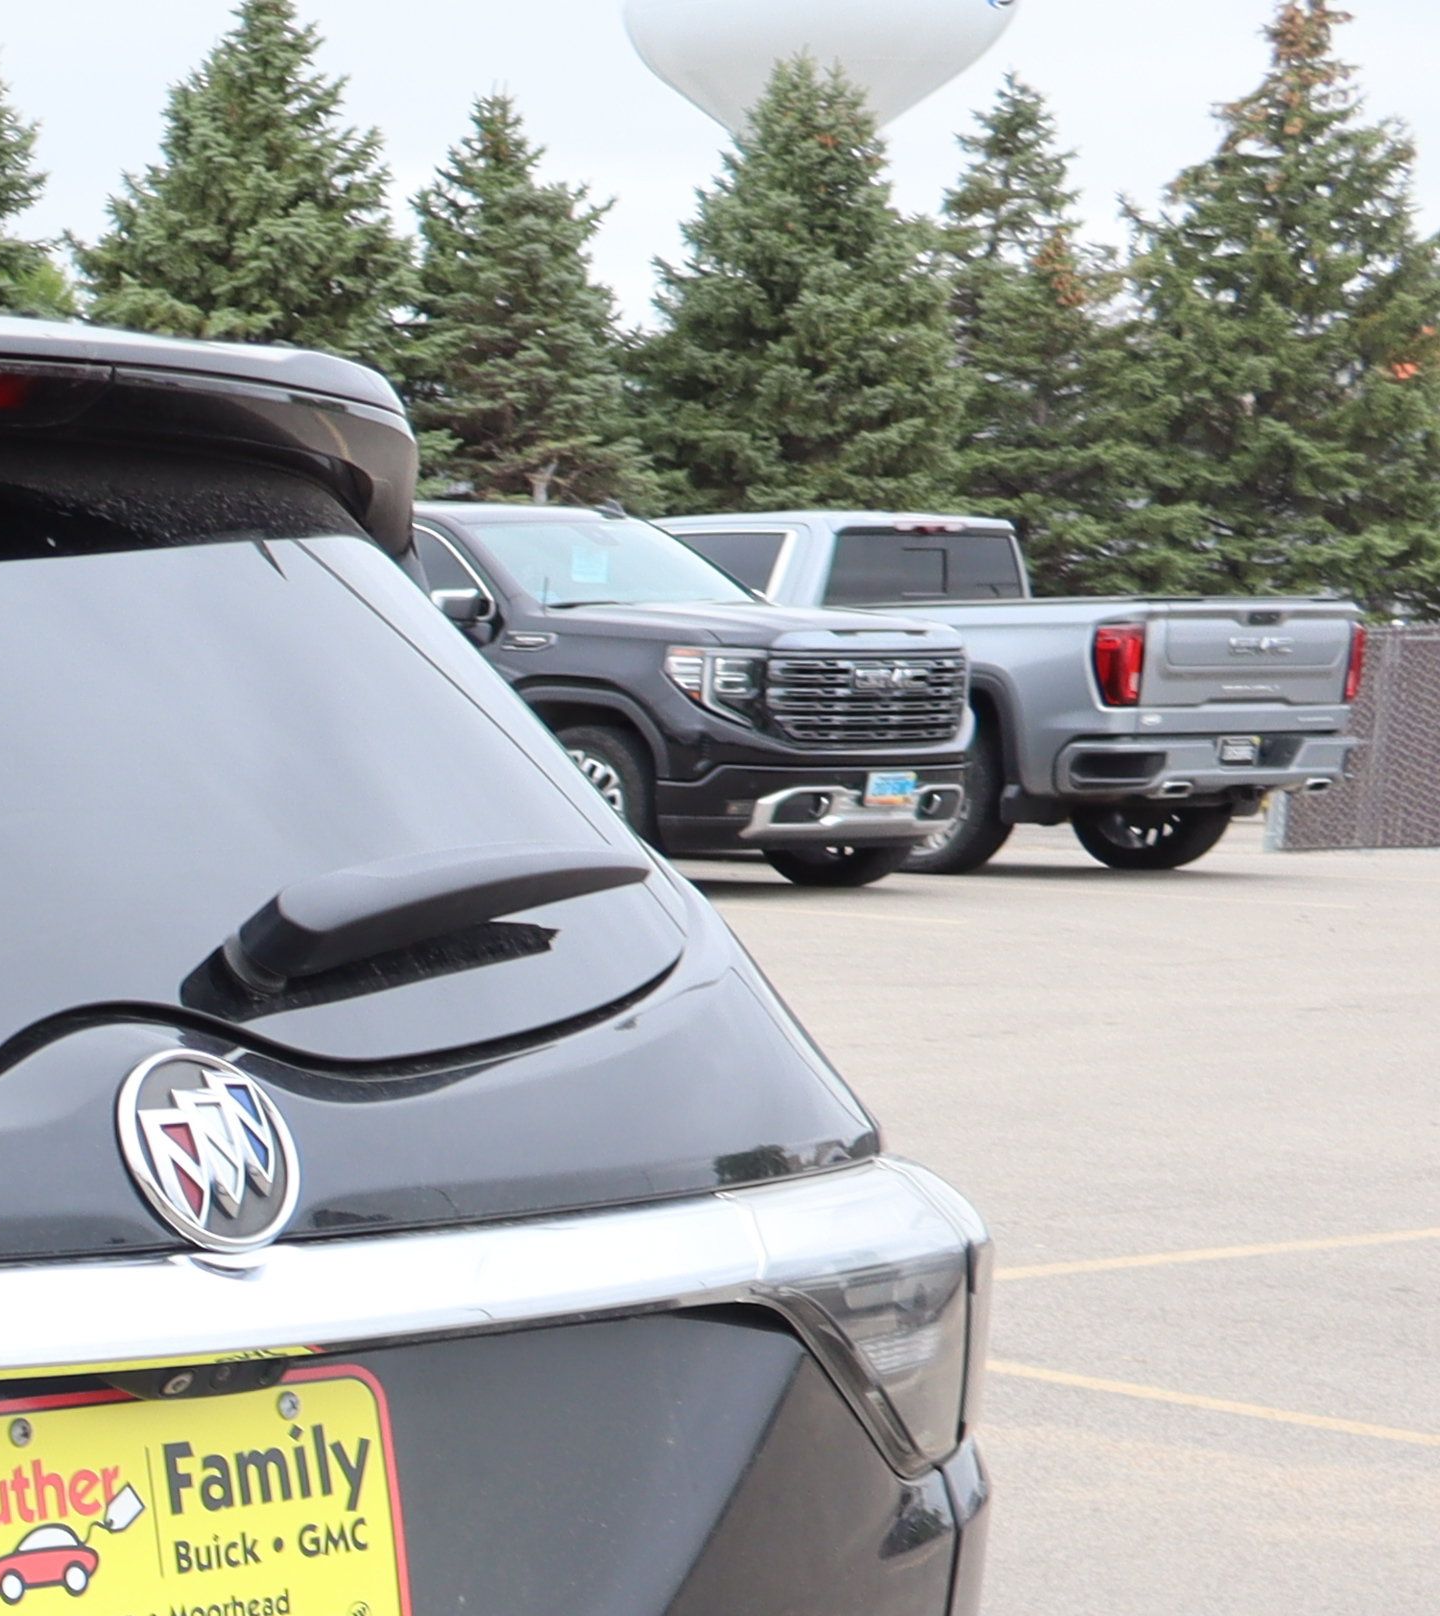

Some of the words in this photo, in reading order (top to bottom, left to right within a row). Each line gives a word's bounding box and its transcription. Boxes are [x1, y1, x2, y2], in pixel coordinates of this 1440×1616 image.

[162, 1423, 371, 1515] Family
[174, 1531, 261, 1574] Buick
[297, 1518, 370, 1558] GMC
